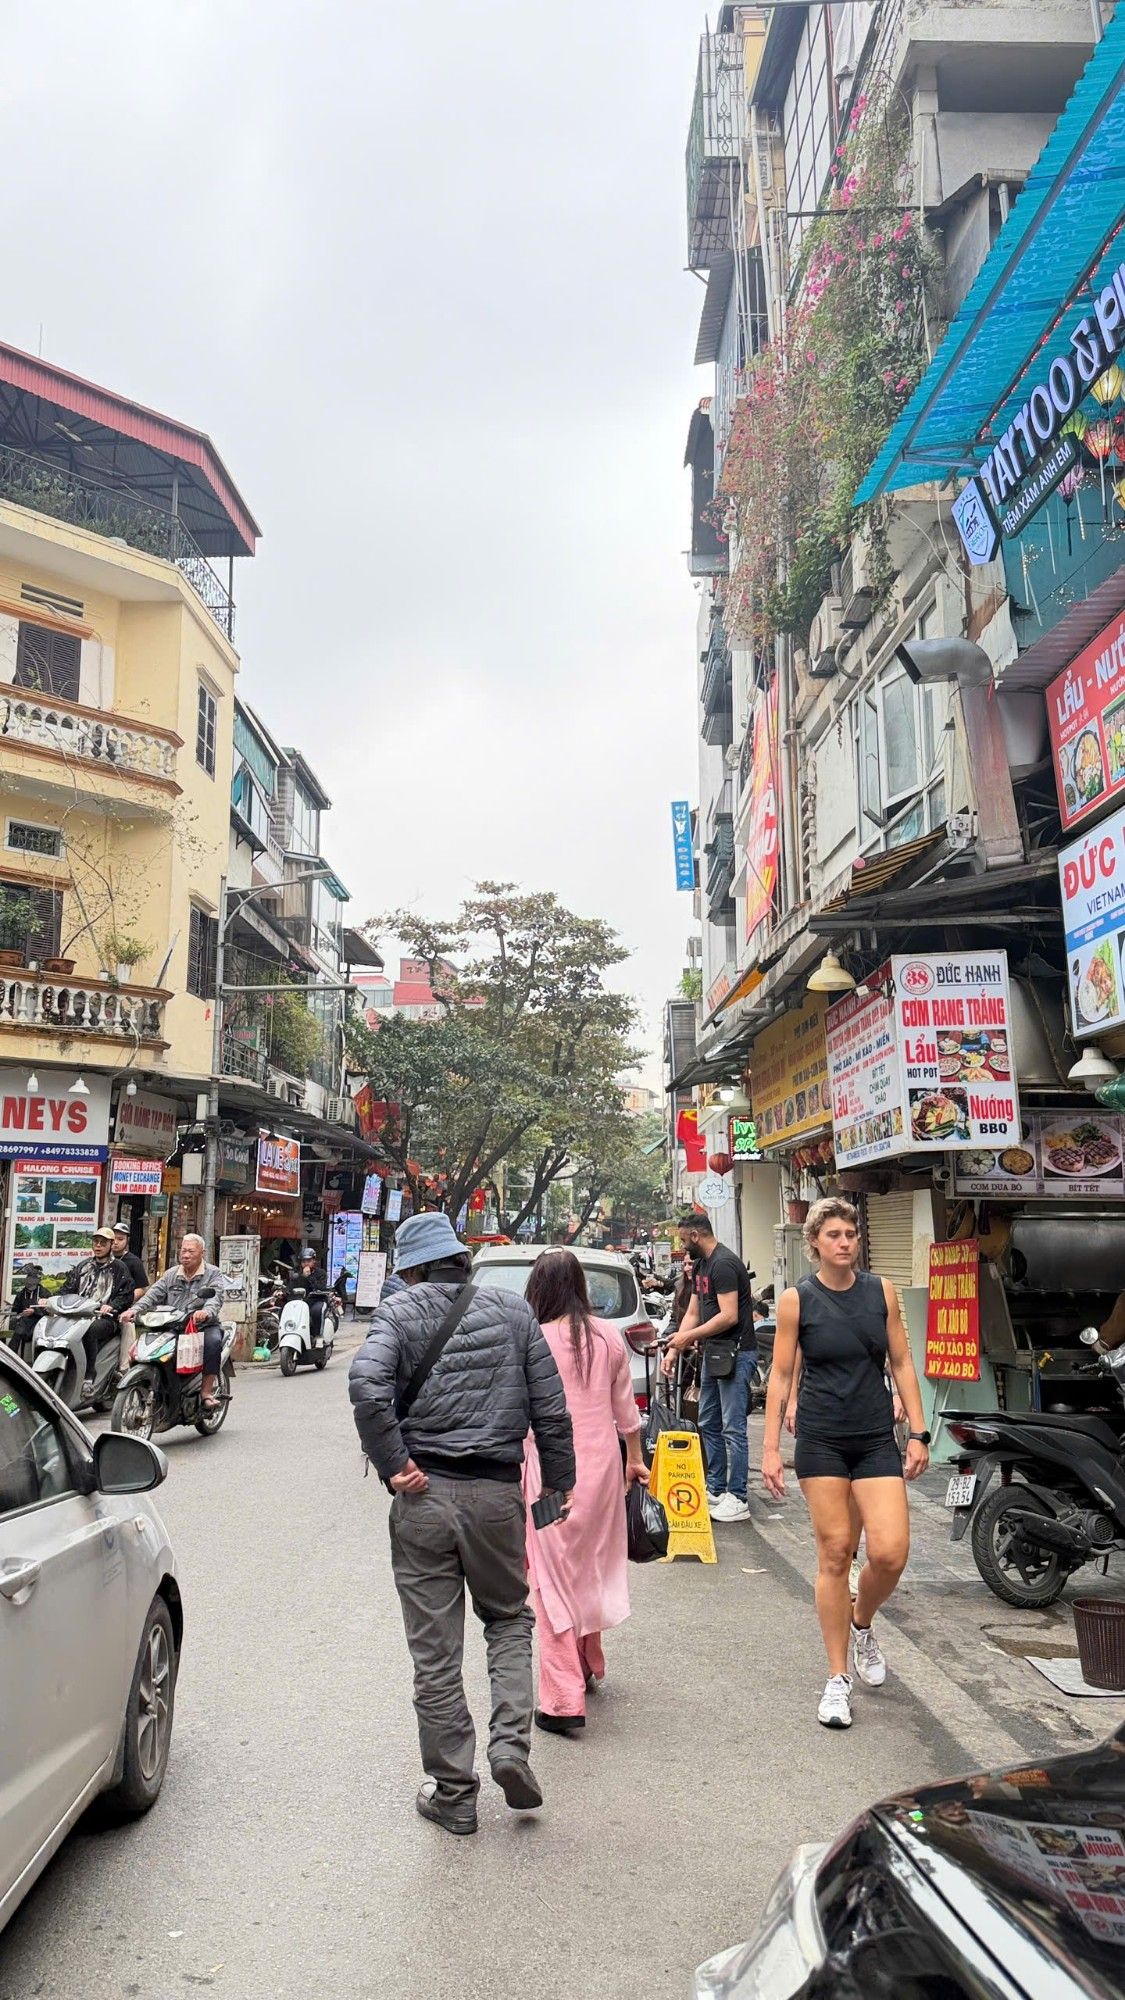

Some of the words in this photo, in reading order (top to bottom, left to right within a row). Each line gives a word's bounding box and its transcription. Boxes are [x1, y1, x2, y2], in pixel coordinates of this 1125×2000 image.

[980, 357, 1076, 505] TATTOO
[1002, 511, 1022, 534] TIỆM
[1019, 482, 1040, 514] XĂM
[1039, 459, 1058, 490] ANH
[1056, 441, 1071, 467] EM
[1056, 669, 1085, 726] LẨU
[1064, 838, 1116, 900] ĐỨC
[907, 970, 928, 985] 38
[936, 962, 961, 983] ĐỨC
[901, 997, 930, 1027] CƠM
[932, 999, 964, 1026] RANG
[862, 1043, 873, 1057] XÀO
[905, 1033, 937, 1064] Lẩu
[907, 1067, 921, 1078] HOT
[924, 1067, 938, 1078] POT
[833, 1084, 849, 1121] Lẩu
[969, 1094, 1014, 1122] Nướng
[2, 1096, 88, 1134] NEYS
[979, 1123, 1008, 1135] BBQ
[23, 1164, 60, 1173] HALONG
[62, 1165, 95, 1174] CRUISE
[113, 1161, 141, 1170] BOOKING
[141, 1161, 162, 1171] OFFICE
[113, 1172, 133, 1182] MONEY
[133, 1173, 160, 1183] EXCHANGE
[115, 1183, 128, 1192] SIM
[129, 1184, 146, 1193] CARD
[149, 1184, 158, 1193] 4G
